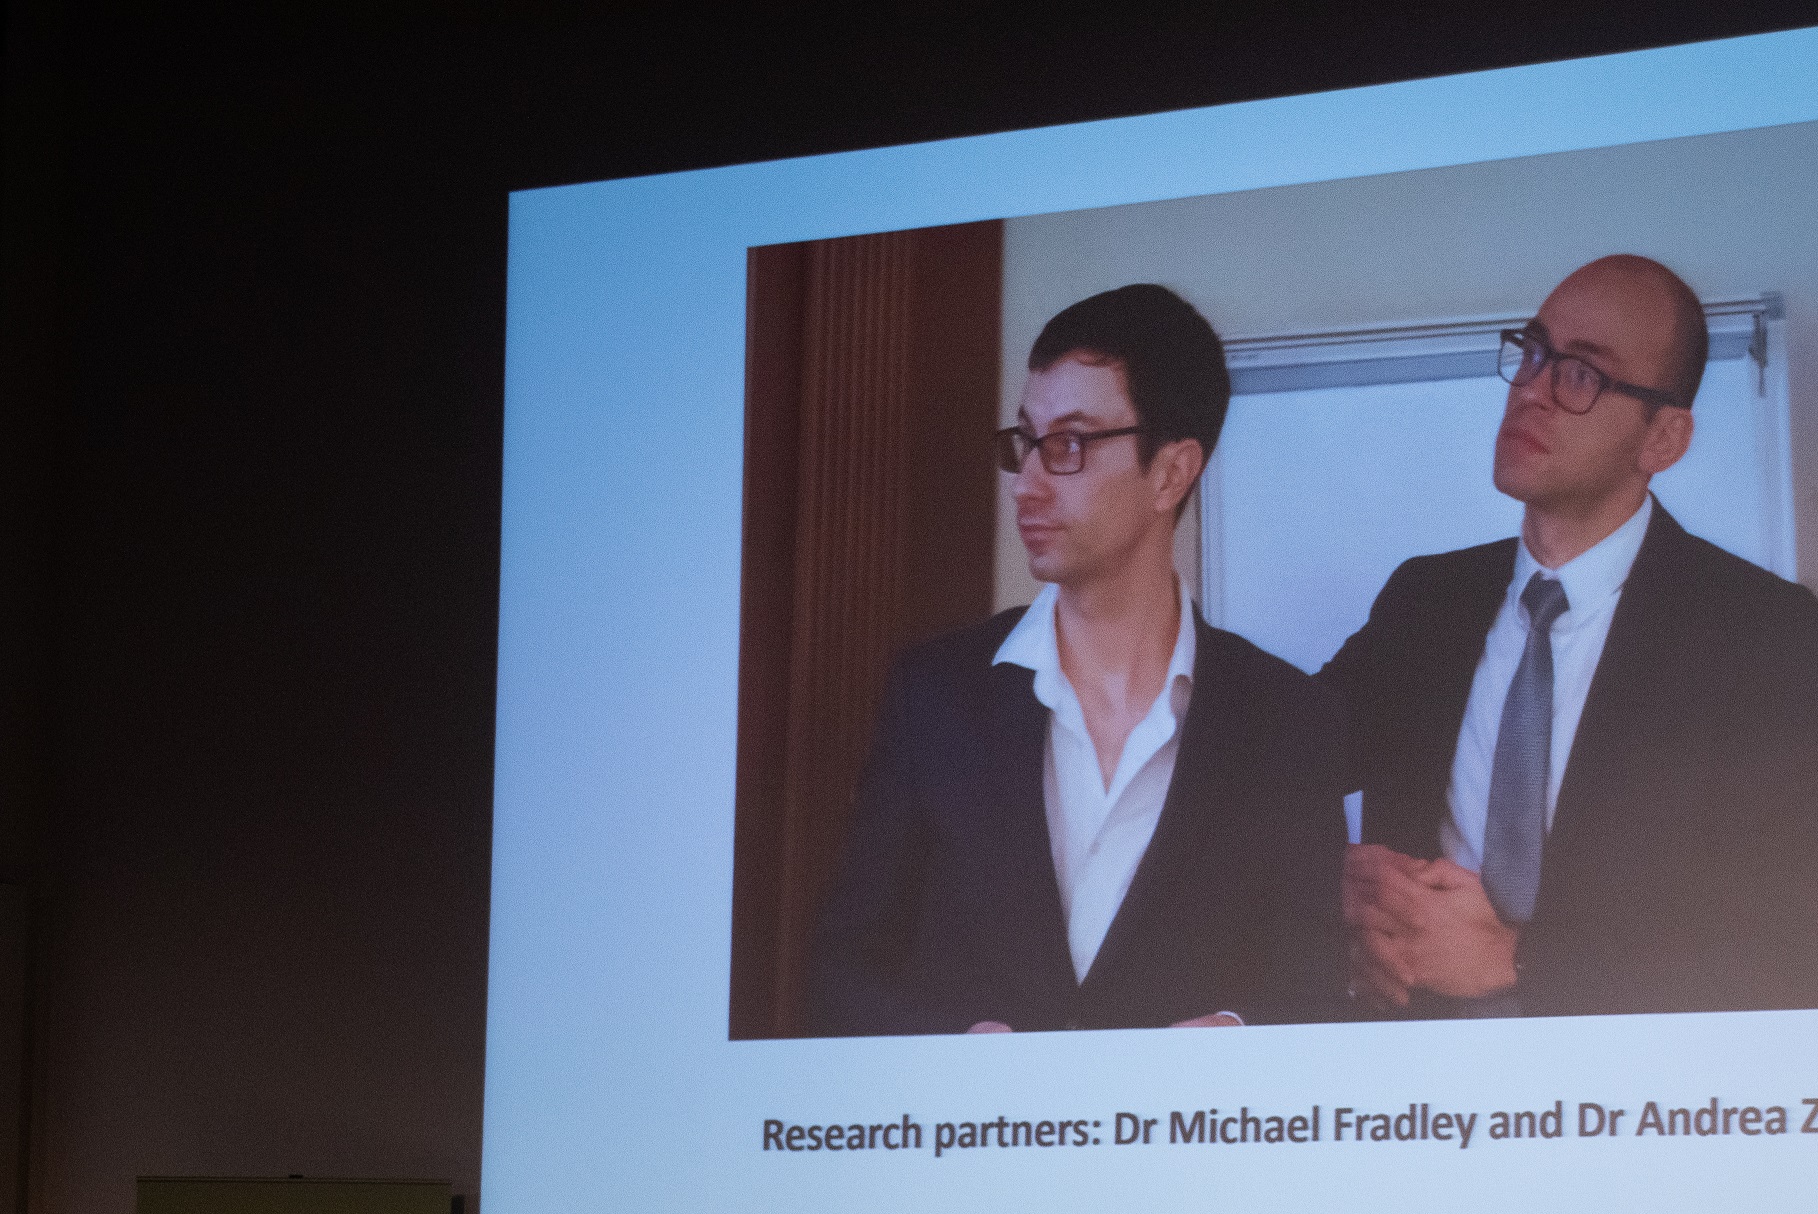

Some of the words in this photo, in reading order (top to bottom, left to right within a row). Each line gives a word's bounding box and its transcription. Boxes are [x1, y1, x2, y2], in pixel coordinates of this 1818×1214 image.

[762, 1113, 923, 1151] Research
[934, 1114, 1102, 1157] partners:
[1114, 1111, 1157, 1146] Dr
[1169, 1105, 1321, 1144] Michael
[1333, 1103, 1477, 1149] Fradley
[1489, 1100, 1563, 1139] and
[1578, 1102, 1624, 1137] Dr
[1636, 1097, 1787, 1137] Andrea
